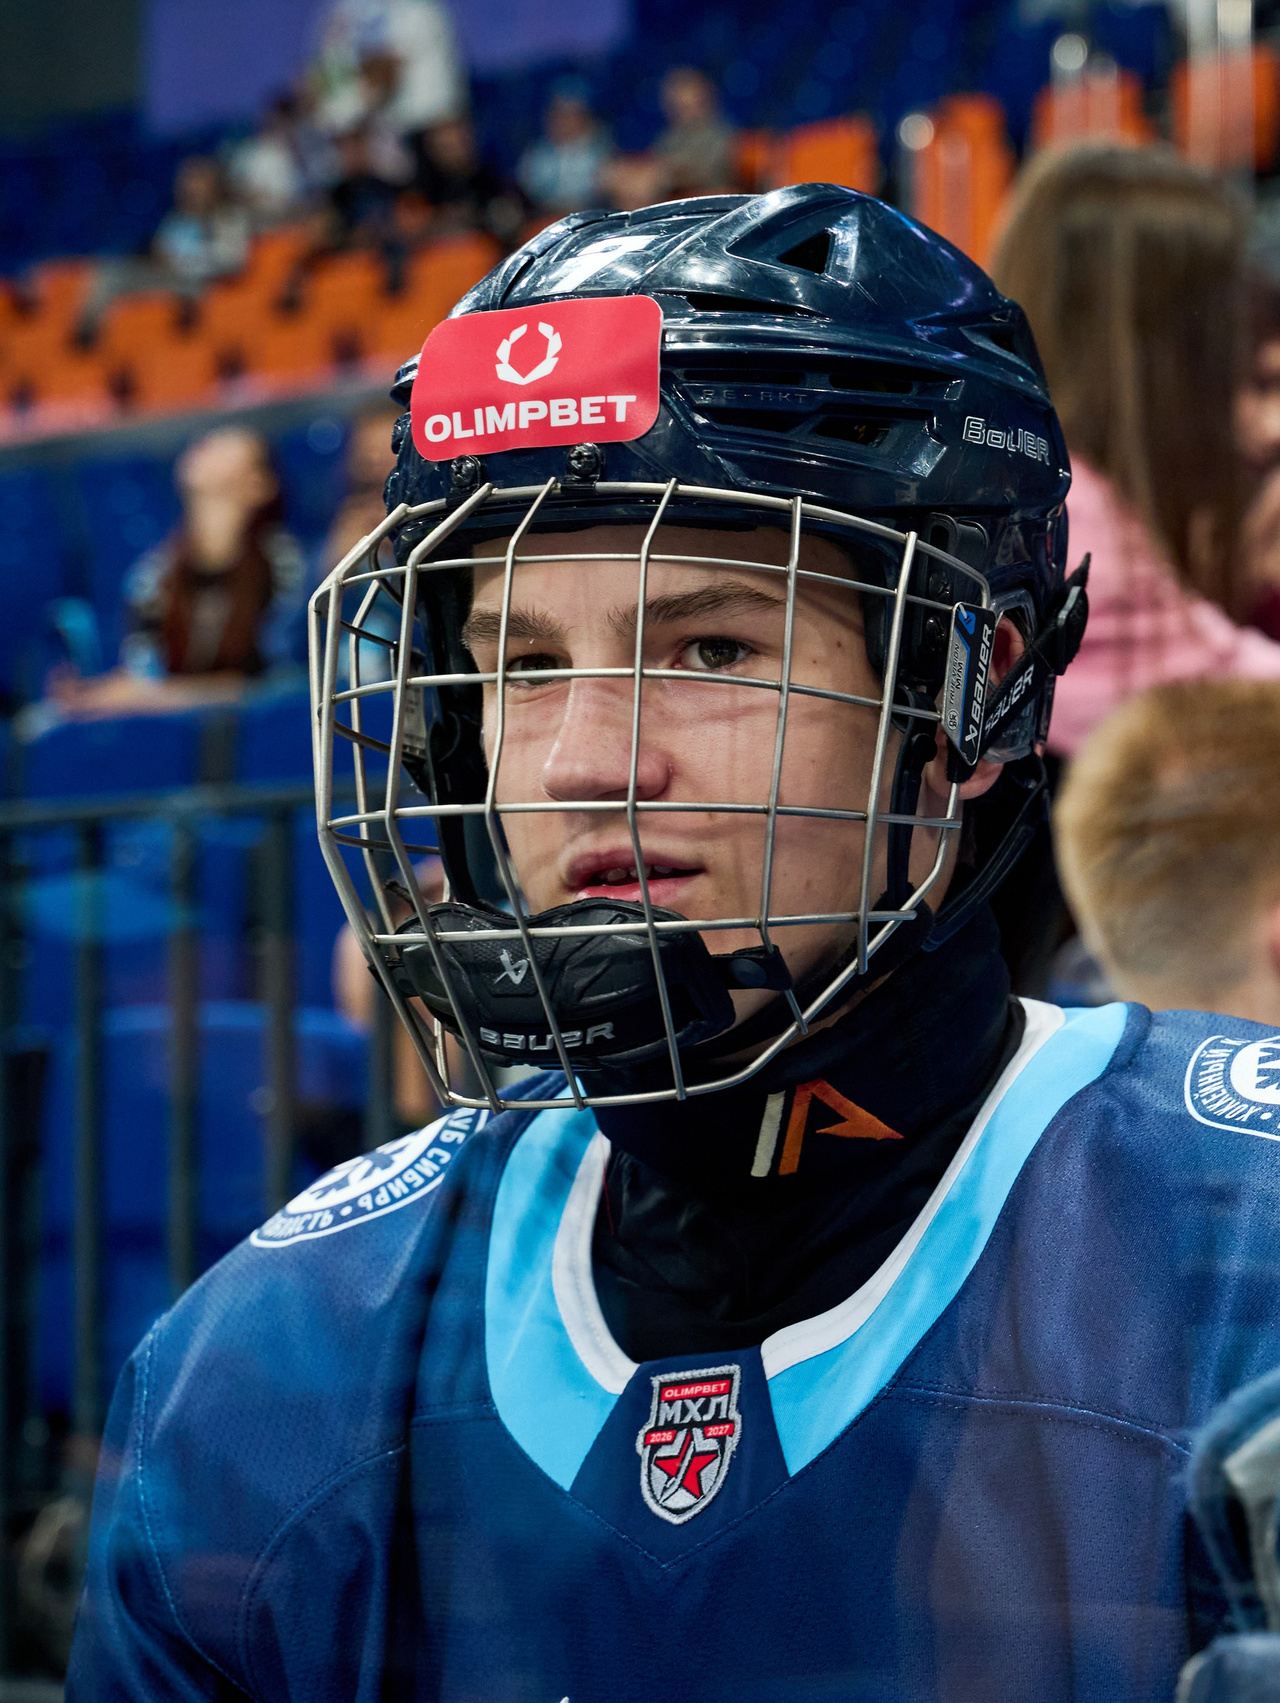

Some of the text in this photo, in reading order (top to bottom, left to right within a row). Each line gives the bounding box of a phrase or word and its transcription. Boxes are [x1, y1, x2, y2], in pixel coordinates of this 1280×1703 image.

[424, 396, 637, 442] OLIMPBET
[971, 623, 992, 724] BAUER
[480, 1022, 615, 1050] BAUER
[357, 1147, 451, 1211] СИБИРЬ
[664, 1382, 727, 1398] OLIMPBET
[658, 1394, 729, 1426] МХЛ
[650, 1425, 729, 1442] 2026 2027
